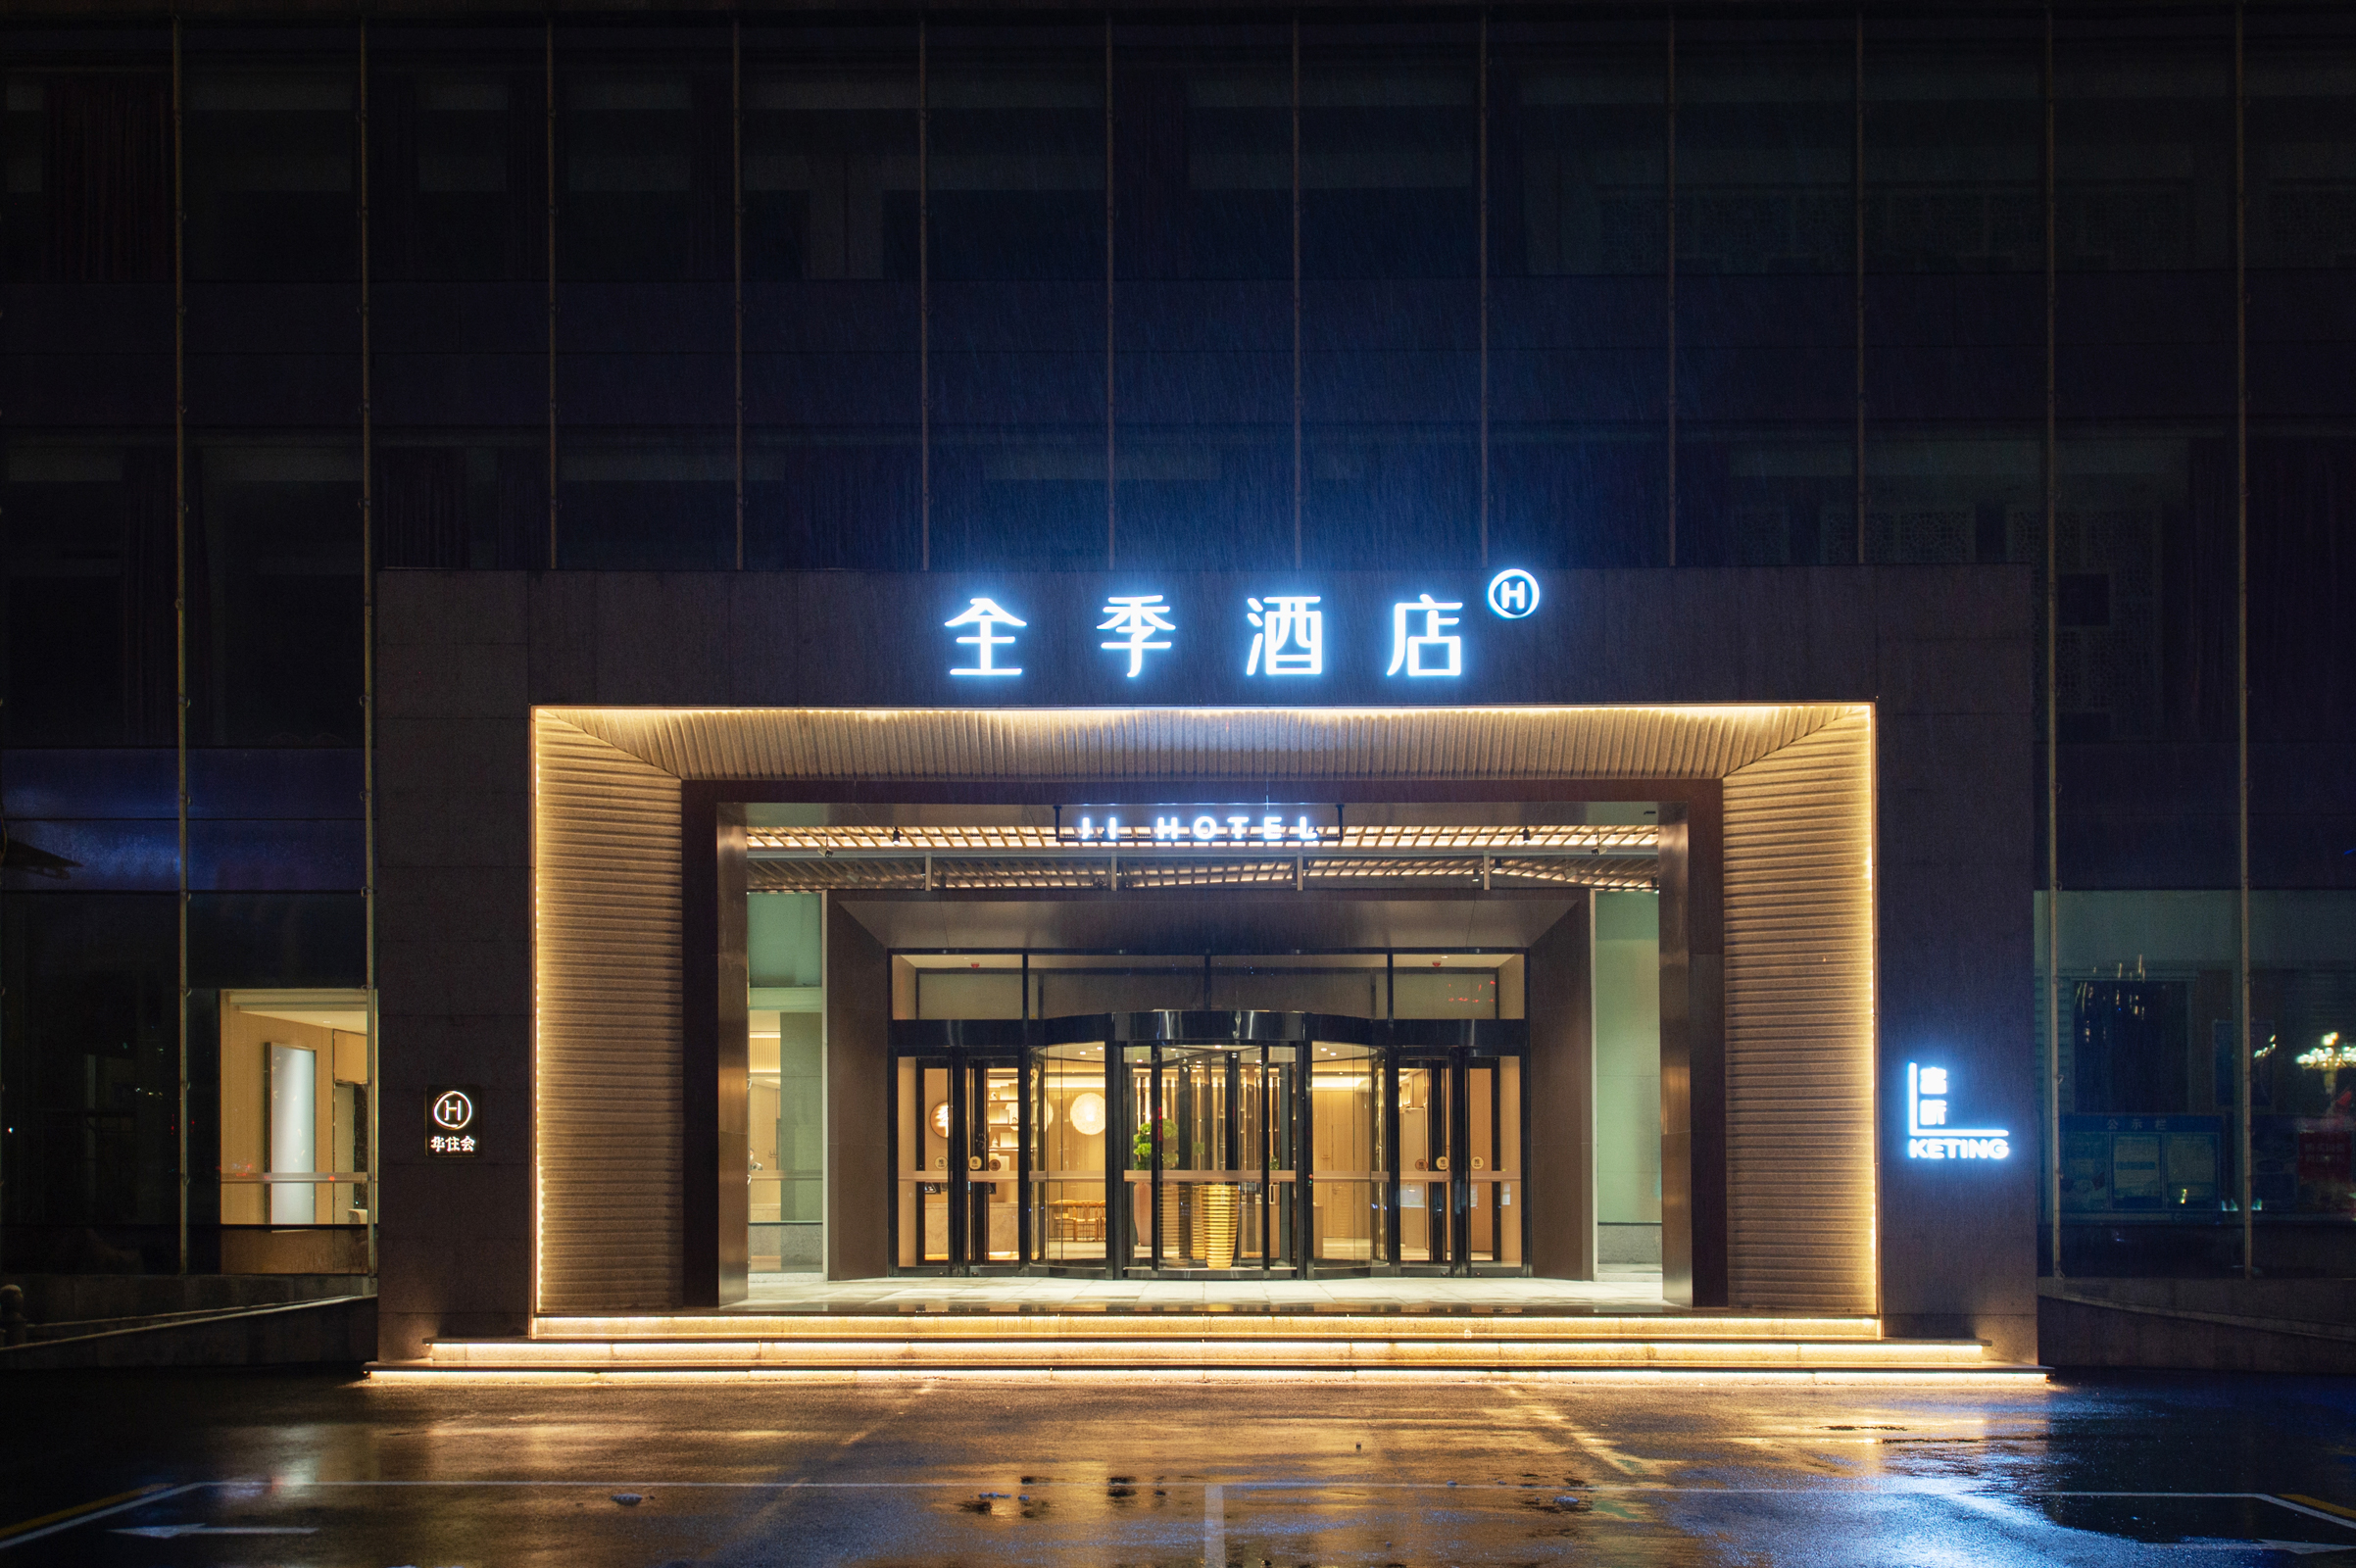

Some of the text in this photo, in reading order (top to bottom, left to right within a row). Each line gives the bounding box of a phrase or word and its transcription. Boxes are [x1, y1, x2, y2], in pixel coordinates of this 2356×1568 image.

[944, 594, 1463, 677] 全季酒店
[1080, 815, 1318, 840] JI HOTEL
[430, 1135, 475, 1152] 华住会
[1908, 1138, 2010, 1160] KETING
